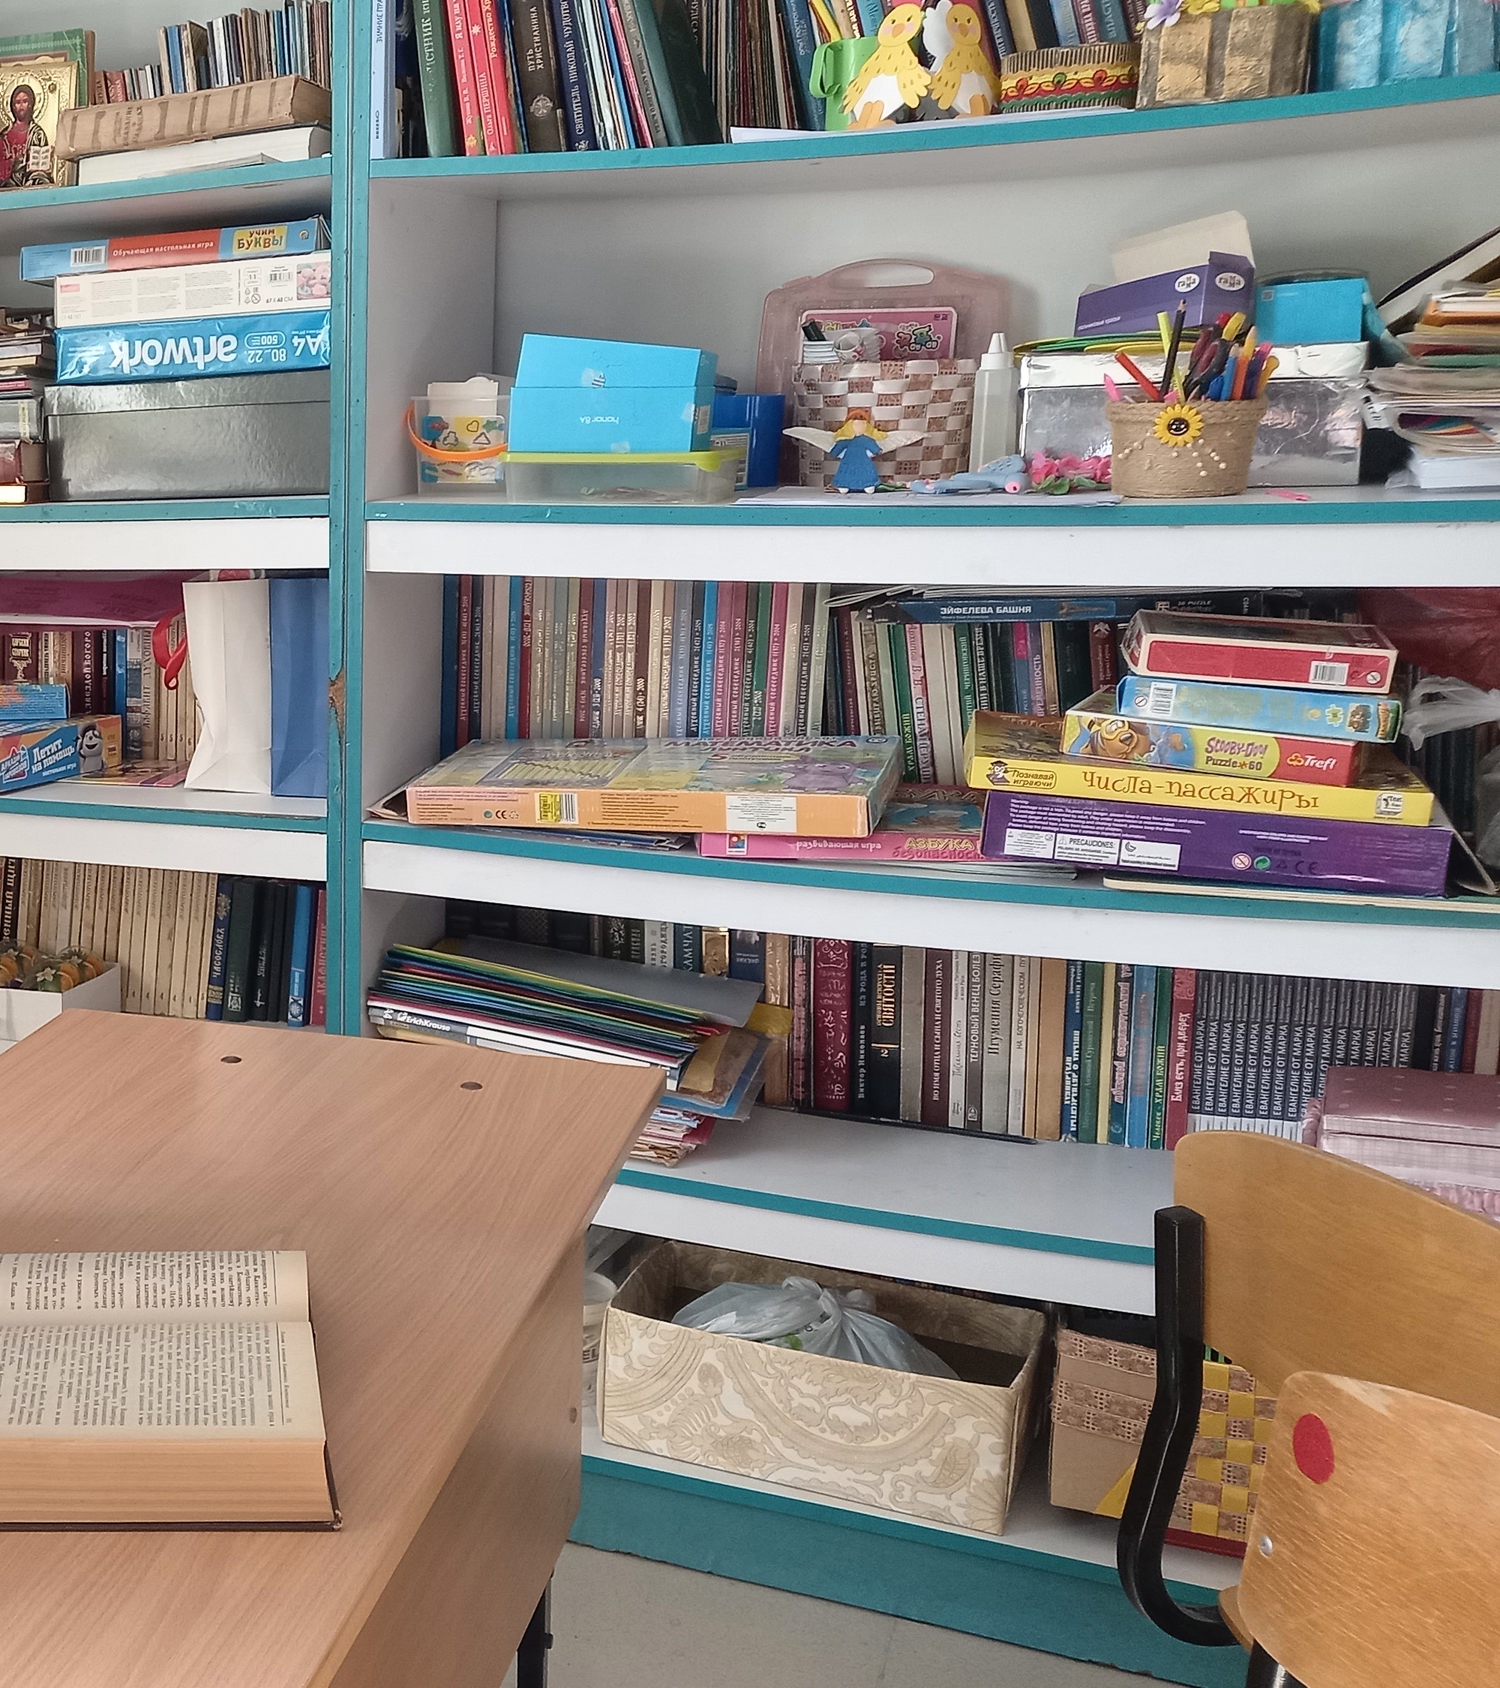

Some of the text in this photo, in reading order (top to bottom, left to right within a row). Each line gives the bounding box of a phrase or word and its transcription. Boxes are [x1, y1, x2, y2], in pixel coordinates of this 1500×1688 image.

[530, 6, 545, 70] ХРИСТИАНИНА
[527, 48, 536, 72] ПУТЬ
[563, 40, 585, 135] СВЯТИТЕЛЬ НИКОЛАЙ
[237, 235, 283, 251] БУКВЫ
[248, 228, 276, 238] УЧИМ
[113, 241, 214, 258] Обучающая настольная игра
[260, 335, 278, 346] 500
[291, 333, 325, 357] A4
[108, 333, 238, 374] artwork
[270, 348, 287, 364] 80
[592, 416, 619, 425] honor
[940, 604, 1032, 616] ЭЙФЕЛЕВА БАШНЯ
[32, 738, 63, 762] Летит
[43, 745, 76, 768] помощь
[1302, 754, 1337, 770] Trefl
[1205, 755, 1263, 771] Puzzle 60
[1012, 770, 1055, 783] Познавай
[1012, 778, 1053, 788] играючи
[795, 840, 882, 851] развивающая игра
[903, 836, 975, 850] АЗБУКА
[1069, 836, 1116, 849] PRECAUCIONES:
[934, 959, 944, 979] ДУХА
[882, 963, 896, 1027] СВЯТОСТИ
[933, 979, 943, 1013] СВЯТОГО
[970, 983, 981, 1013] ВЕНЕЦ
[407, 1016, 451, 1032] ErichKrause
[933, 1021, 942, 1043] СЫНА
[986, 1000, 1004, 1056] Игумения
[858, 1024, 867, 1067] Николаев
[969, 1014, 980, 1063] ТЕРНОВЫЙ
[1015, 1040, 1024, 1050] НА
[1175, 1042, 1187, 1057] при
[1304, 1026, 1317, 1070] ОТ МАРКА
[1322, 1027, 1333, 1058] МАРКА
[1335, 1028, 1348, 1059] МАРКА
[1350, 1029, 1362, 1060] МАРКА
[1365, 1030, 1377, 1061] МАРКА
[1380, 1030, 1393, 1061] МАРКА
[1399, 1031, 1411, 1062] МАРКА
[932, 1051, 941, 1072] ОТЦА
[1155, 1045, 1167, 1077] БОЖИЙ
[1174, 1057, 1187, 1081] есть,
[1191, 1019, 1206, 1110] ЕВАНГЕЛИЕ ОТ МАРКА
[1204, 1020, 1219, 1112] ЕВАНГЕЛИЕ ОТ МАРКА
[1217, 1022, 1232, 1113] ЕВАНГЕЛИЕ ОТ МАРКА
[1231, 1023, 1246, 1114] ЕВАНГЕЛИЕ ОТ МАРКА
[1245, 1024, 1260, 1115] ЕВАНГЕЛИЕ ОТ МАРКА
[1259, 1024, 1274, 1116] ЕВАНГЕЛИЕ ОТ МАРКА
[1273, 1025, 1288, 1116] ЕВАНГЕЛИЕ ОТ МАРКА
[1288, 1027, 1303, 1118] ЕВАНГЕЛИЕ ОТ МАРКА
[932, 1072, 941, 1090] ИМЯ
[1154, 1078, 1165, 1104] ХРАМ
[1171, 1081, 1184, 1103] Близ
[932, 1091, 941, 1101] ВО
